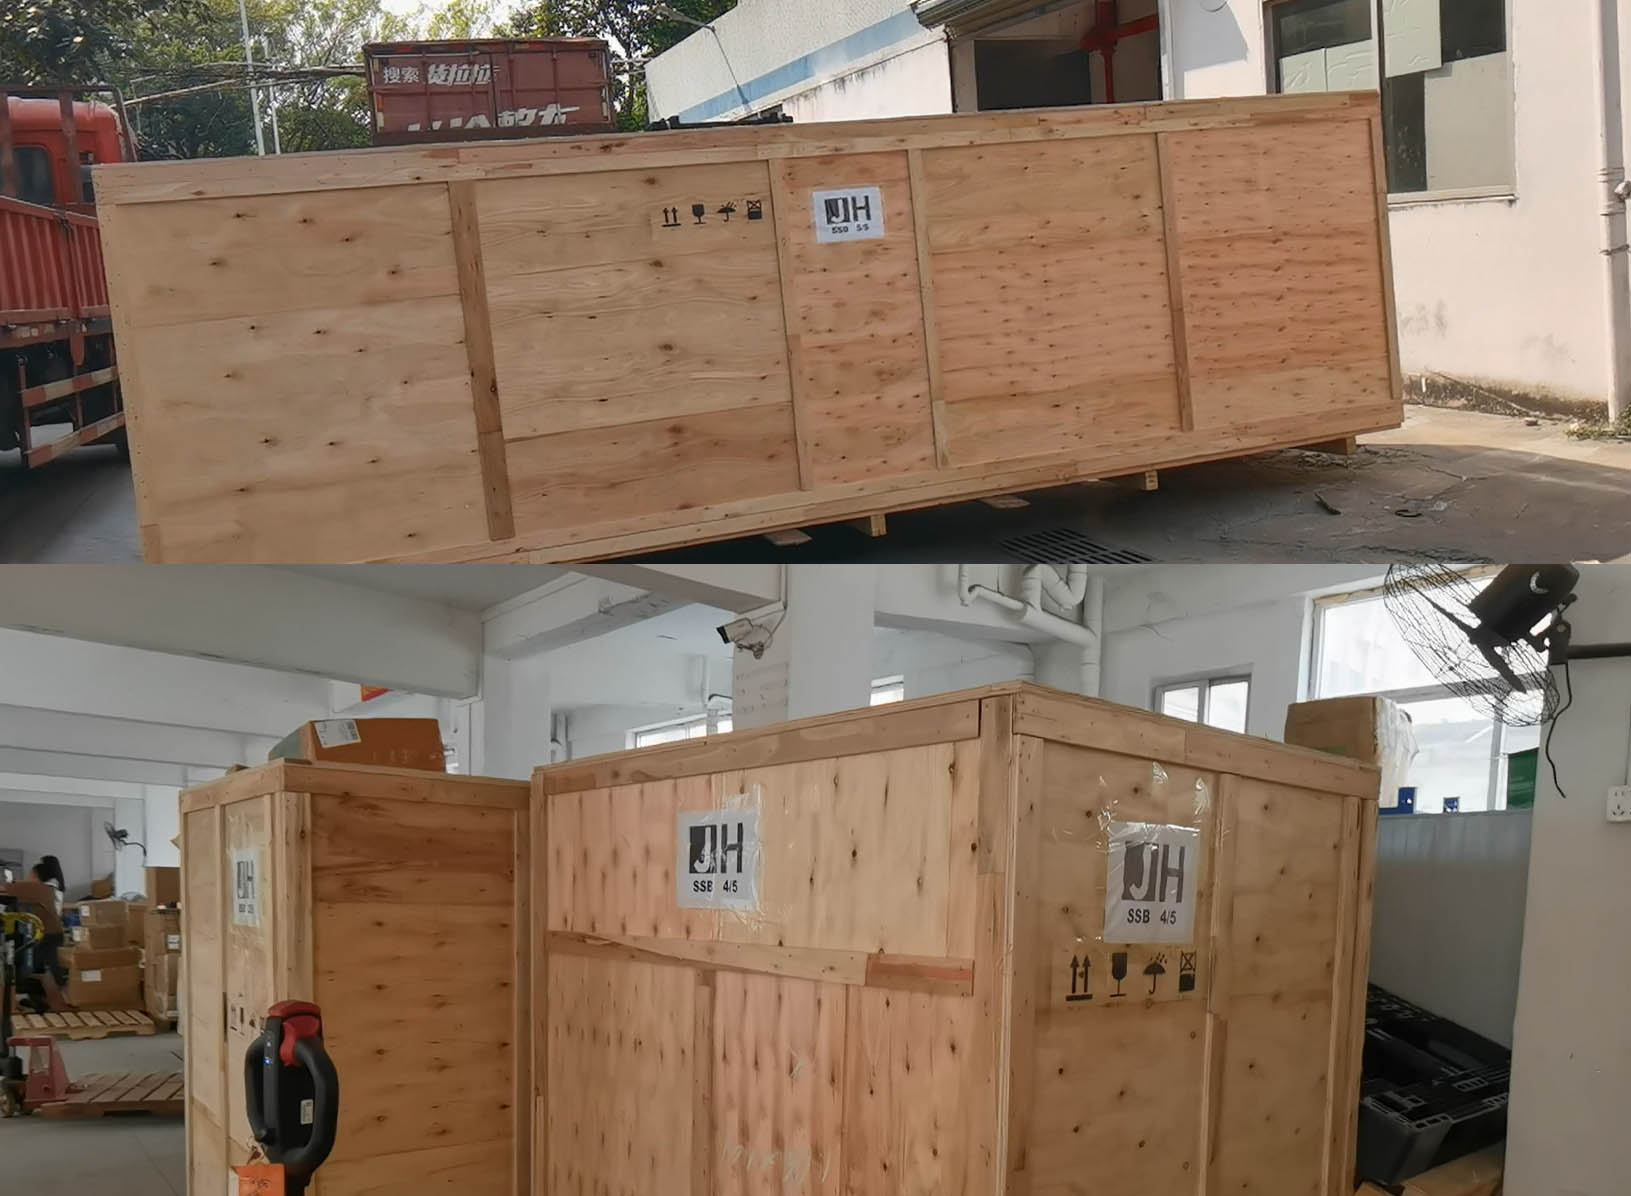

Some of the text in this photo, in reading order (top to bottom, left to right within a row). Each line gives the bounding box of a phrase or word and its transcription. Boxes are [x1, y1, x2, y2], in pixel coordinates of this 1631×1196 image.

[383, 66, 419, 84] 搜索
[824, 195, 872, 225] JH
[689, 822, 743, 874] JH
[1121, 840, 1185, 904] JH
[693, 880, 738, 893] SSB 4/5
[1127, 908, 1177, 926] SSB 4/5
